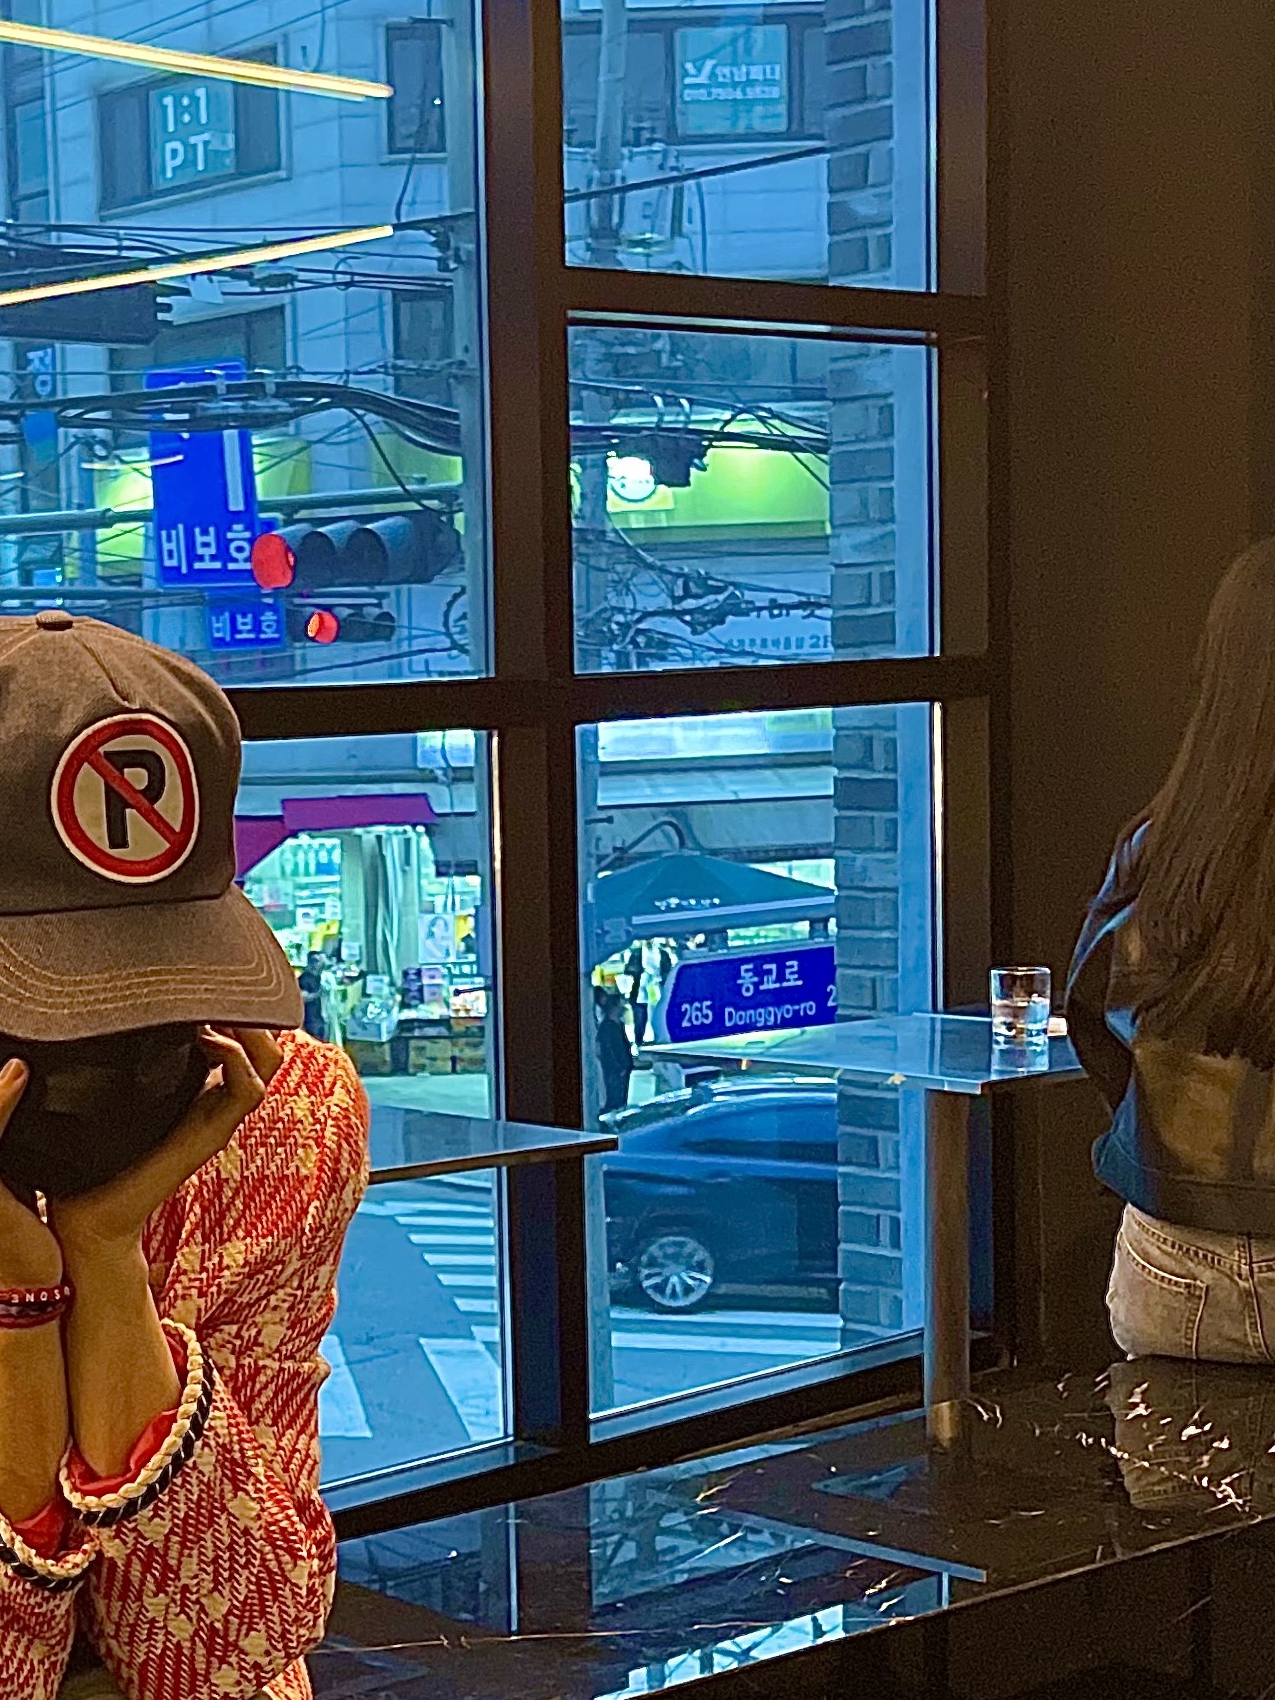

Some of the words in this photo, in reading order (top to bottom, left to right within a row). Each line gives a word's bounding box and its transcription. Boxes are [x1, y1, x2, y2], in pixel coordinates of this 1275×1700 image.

[162, 87, 208, 132] 1:1
[165, 132, 211, 178] PT
[161, 523, 252, 574] 비보호
[211, 611, 280, 641] 비보호
[736, 960, 804, 997] 동교로
[681, 1001, 714, 1028] 265
[724, 1001, 817, 1027] Donggyo-ro
